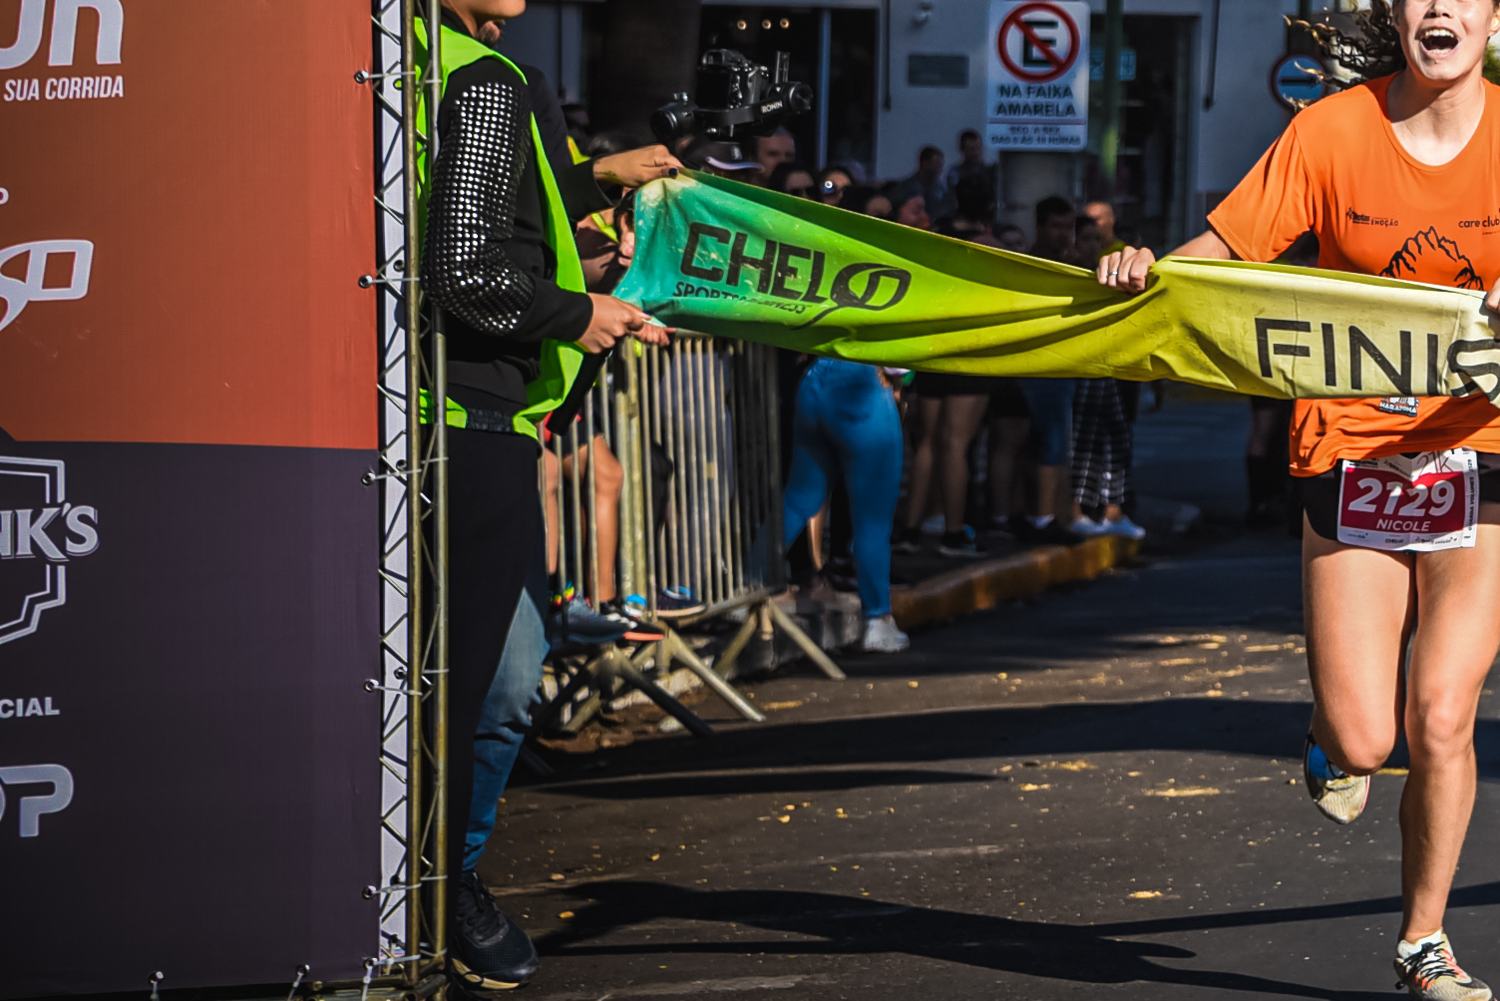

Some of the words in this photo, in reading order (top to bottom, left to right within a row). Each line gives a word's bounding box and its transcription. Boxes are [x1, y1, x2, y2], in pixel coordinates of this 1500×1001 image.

[1023, 20, 1059, 67] E
[4, 79, 40, 101] SUA
[45, 76, 124, 99] CORRIDA
[999, 85, 1022, 98] NA
[1026, 85, 1074, 99] FAIXA
[761, 100, 783, 114] RONIN
[996, 102, 1076, 116] AMARELA
[1458, 219, 1480, 229] care
[1482, 214, 1500, 228] club
[680, 221, 912, 316] CHELO
[1348, 477, 1455, 517] 2129
[1376, 519, 1431, 532] NICOLE
[0, 697, 60, 719] CIAL
